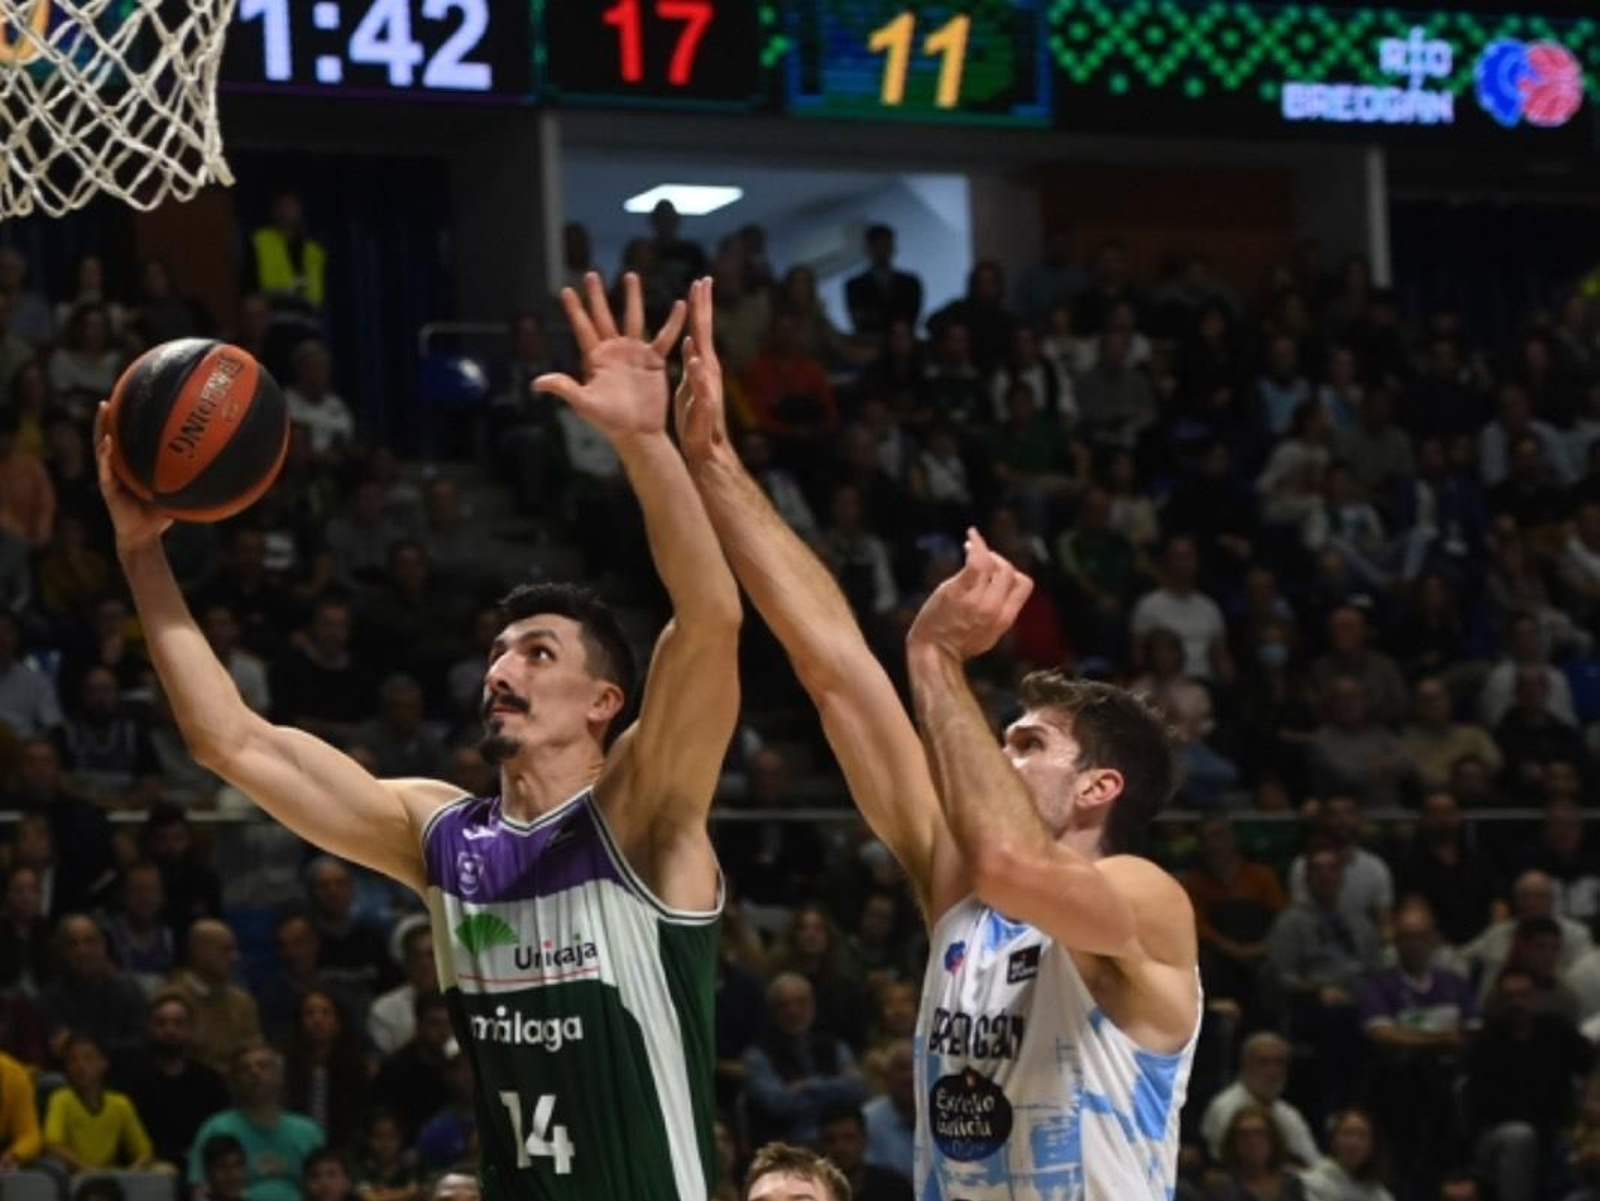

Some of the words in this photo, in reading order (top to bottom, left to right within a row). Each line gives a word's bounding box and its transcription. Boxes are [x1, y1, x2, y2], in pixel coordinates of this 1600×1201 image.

[238, 0, 492, 90] 1:42
[603, 0, 714, 85] 17
[868, 11, 970, 109] 11
[514, 933, 598, 970] Unicaja
[499, 1091, 575, 1175] 14
